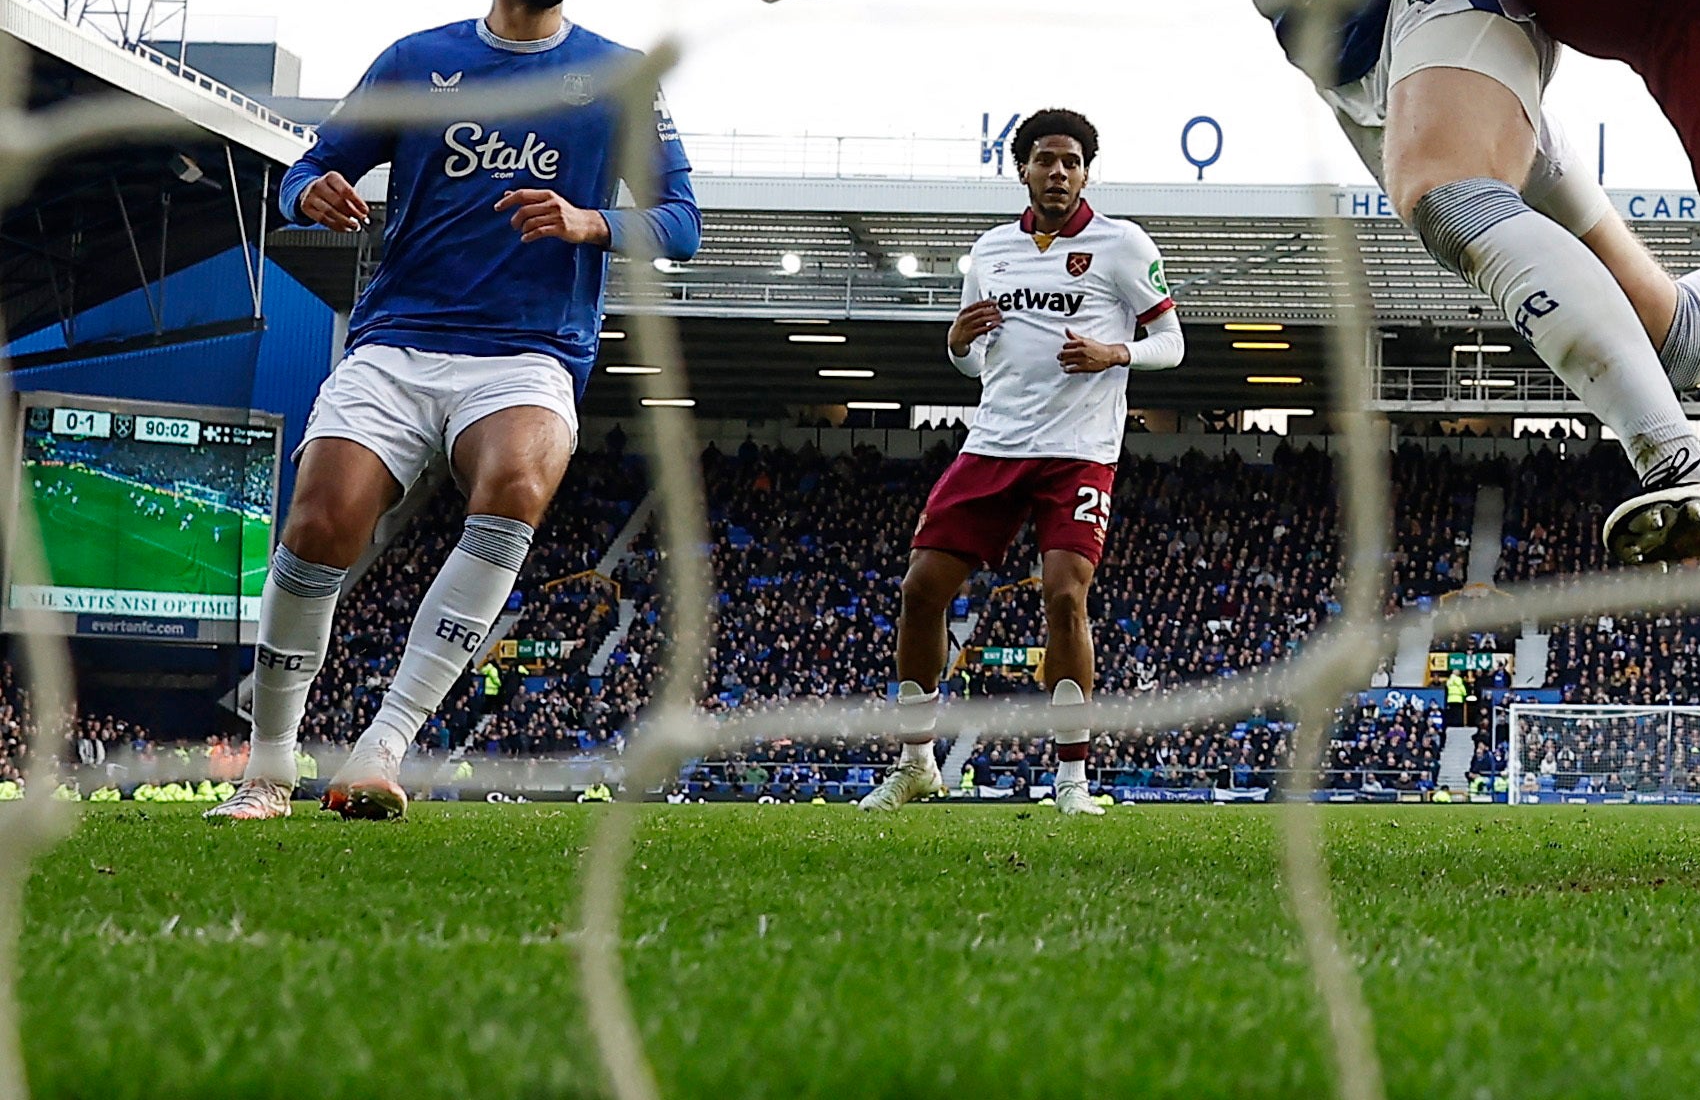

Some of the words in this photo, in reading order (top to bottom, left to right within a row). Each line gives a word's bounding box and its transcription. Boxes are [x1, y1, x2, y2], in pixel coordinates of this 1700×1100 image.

[444, 122, 560, 180] Stake
[1330, 194, 1393, 216] THE
[66, 413, 95, 433] 0-1
[146, 421, 189, 438] 90:02
[1074, 486, 1111, 532] 25
[64, 593, 116, 609] SATIS
[121, 596, 157, 611] NISI
[92, 618, 185, 635] evertonfc.com
[435, 618, 482, 653] EFC
[257, 652, 303, 671] EFC
